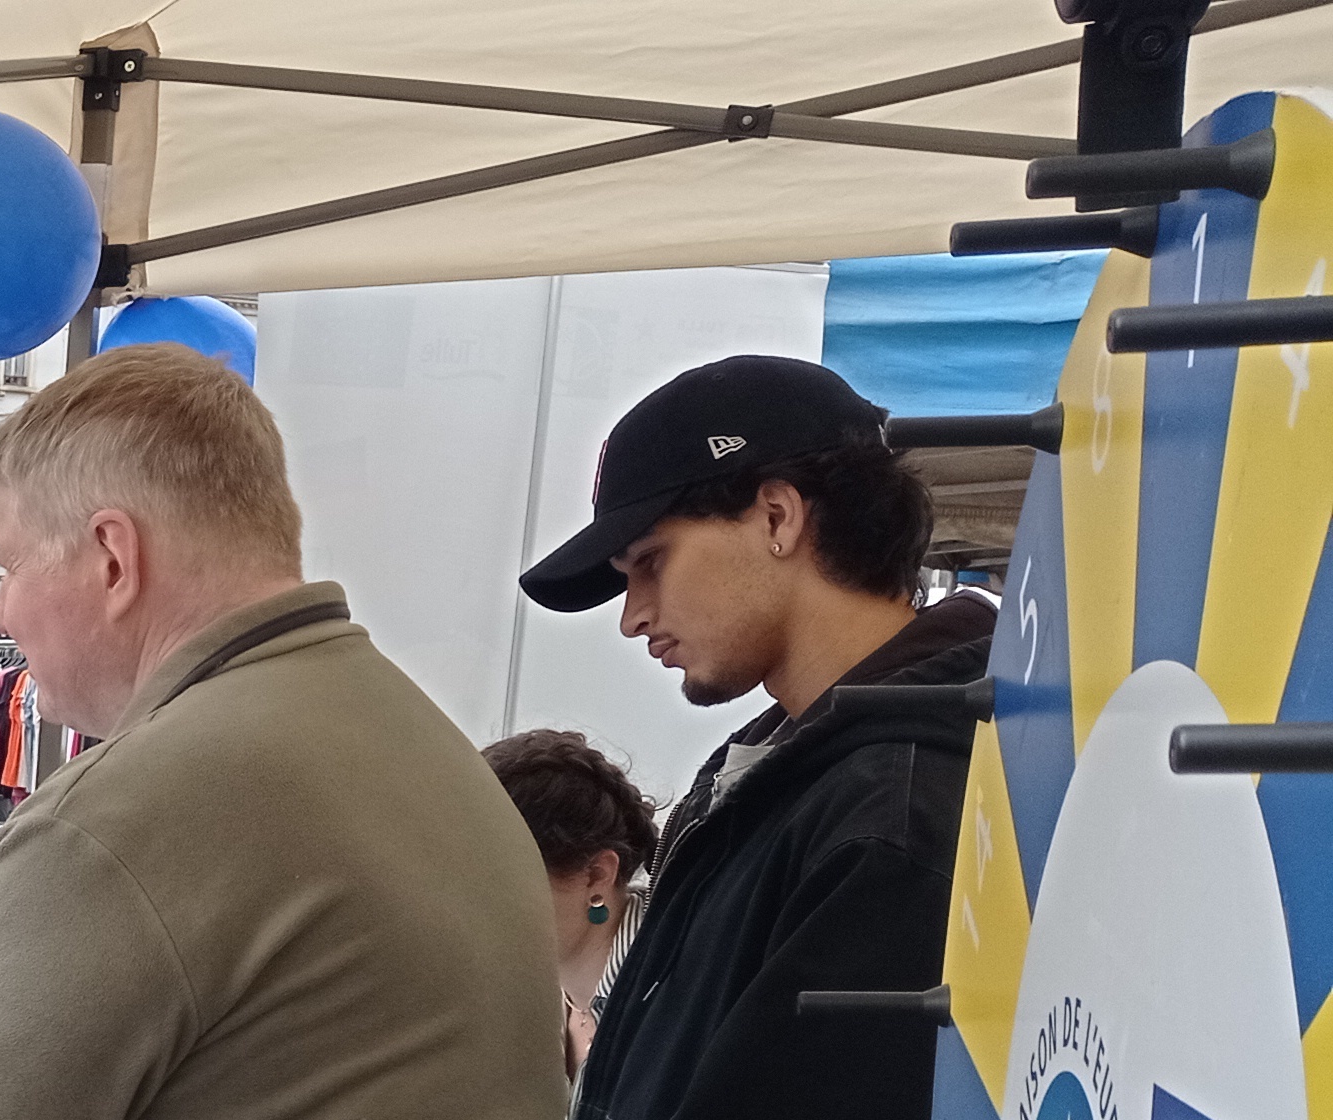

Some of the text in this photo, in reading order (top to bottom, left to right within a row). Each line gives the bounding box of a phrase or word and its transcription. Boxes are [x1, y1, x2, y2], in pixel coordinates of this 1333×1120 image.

[1187, 211, 1209, 369] 1
[1019, 555, 1038, 686] 5
[1062, 995, 1082, 1051] DE
